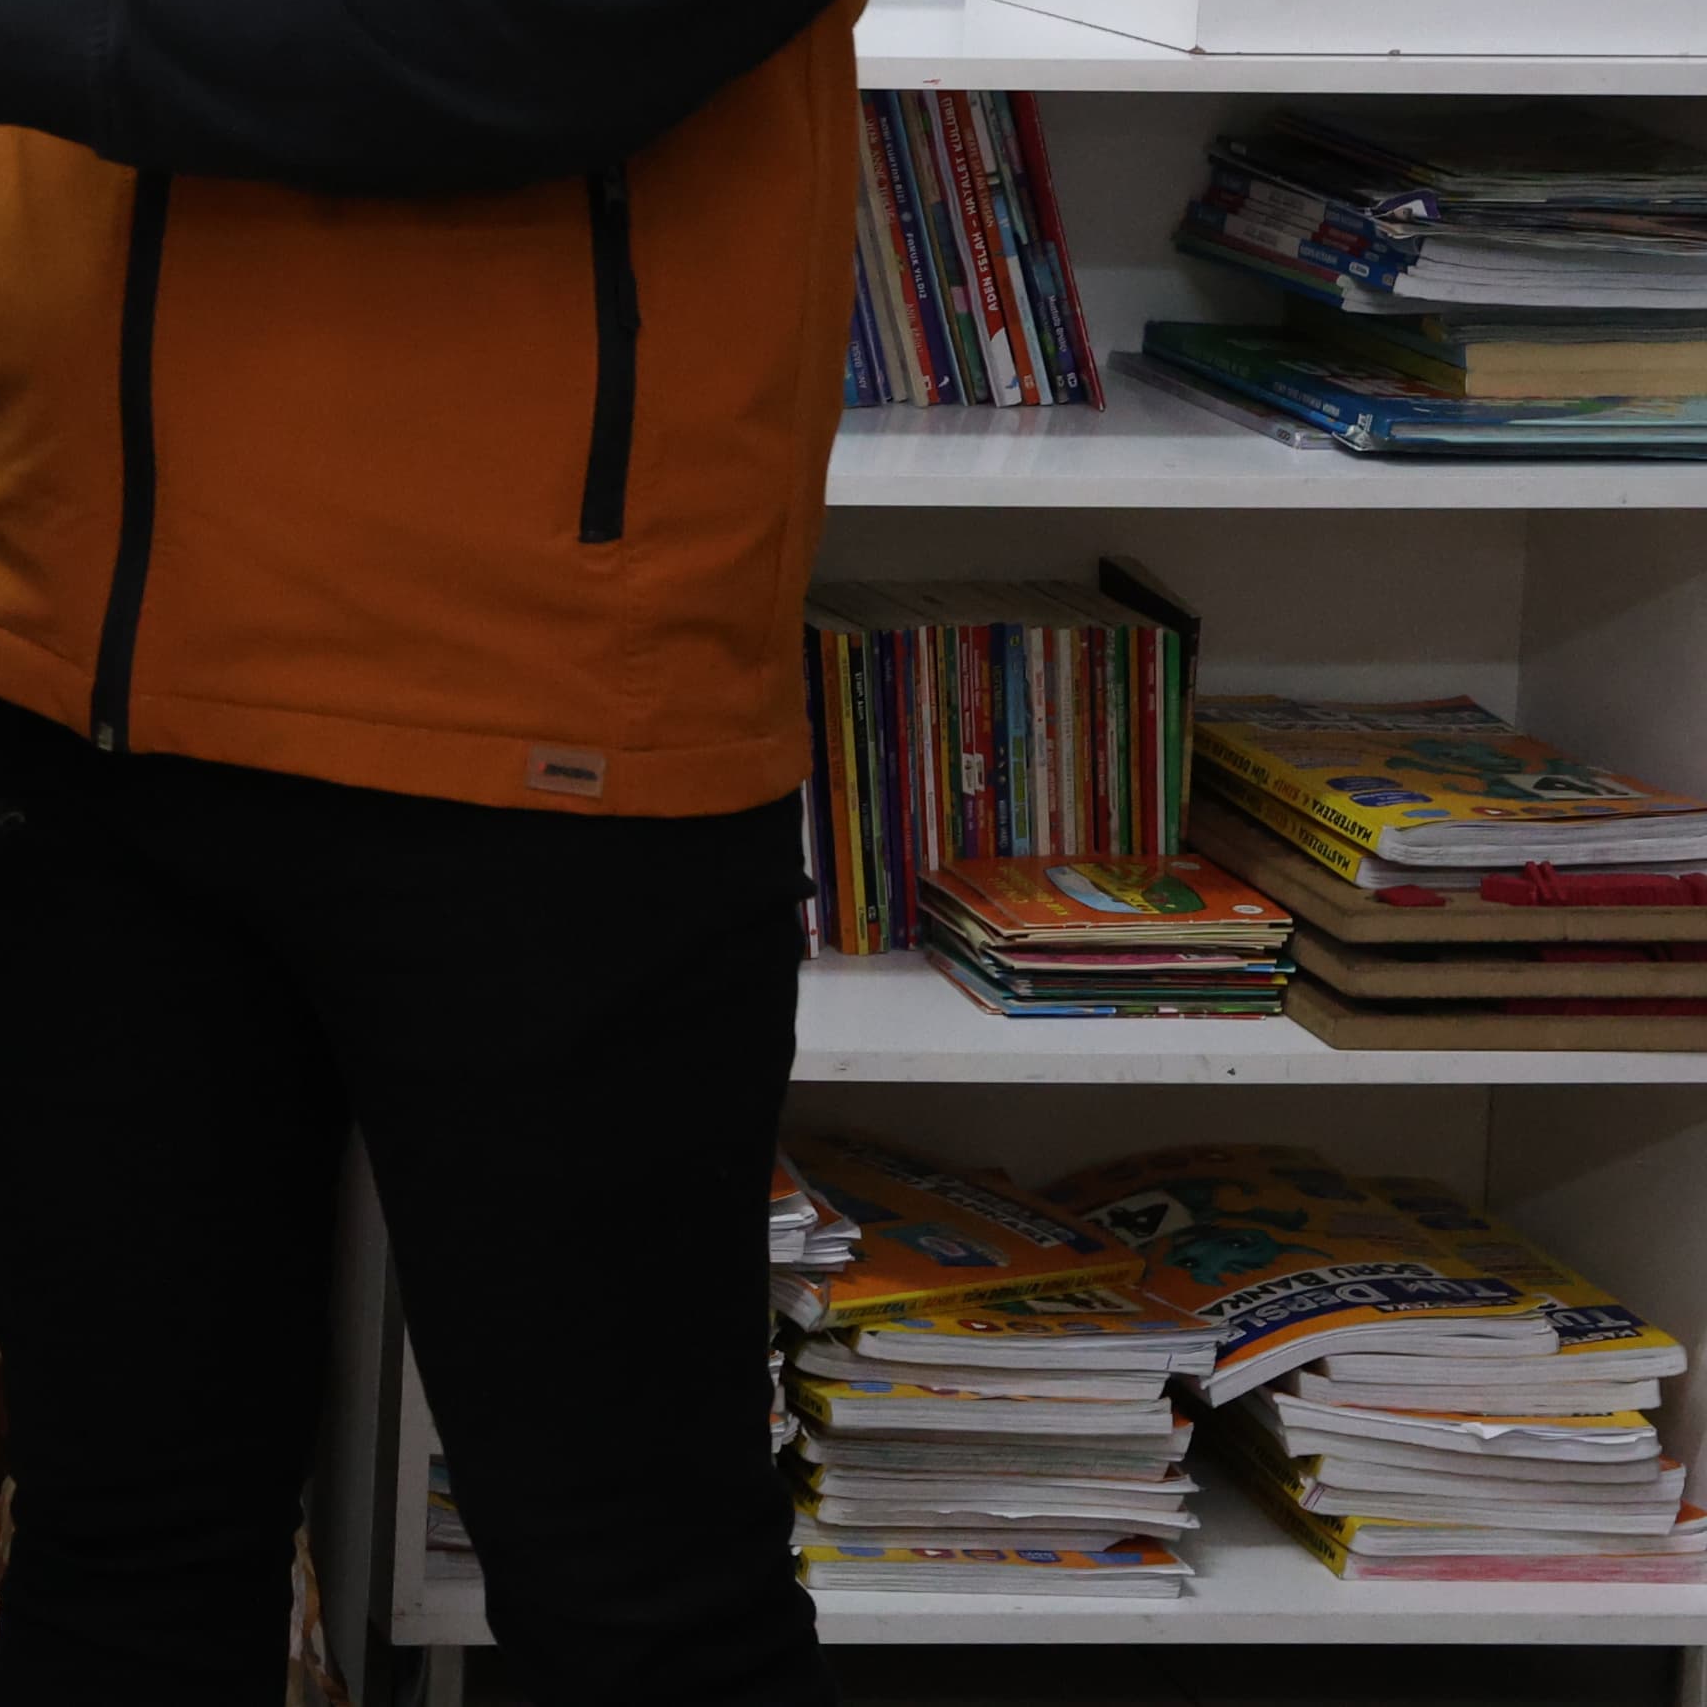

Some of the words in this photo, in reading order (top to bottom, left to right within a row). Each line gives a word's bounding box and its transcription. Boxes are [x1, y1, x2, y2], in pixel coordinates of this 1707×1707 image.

[954, 157, 978, 214] HAYALET
[981, 277, 999, 311] ADEN
[1311, 798, 1372, 841] MASTERZEKA
[1195, 1272, 1324, 1319] BANKA
